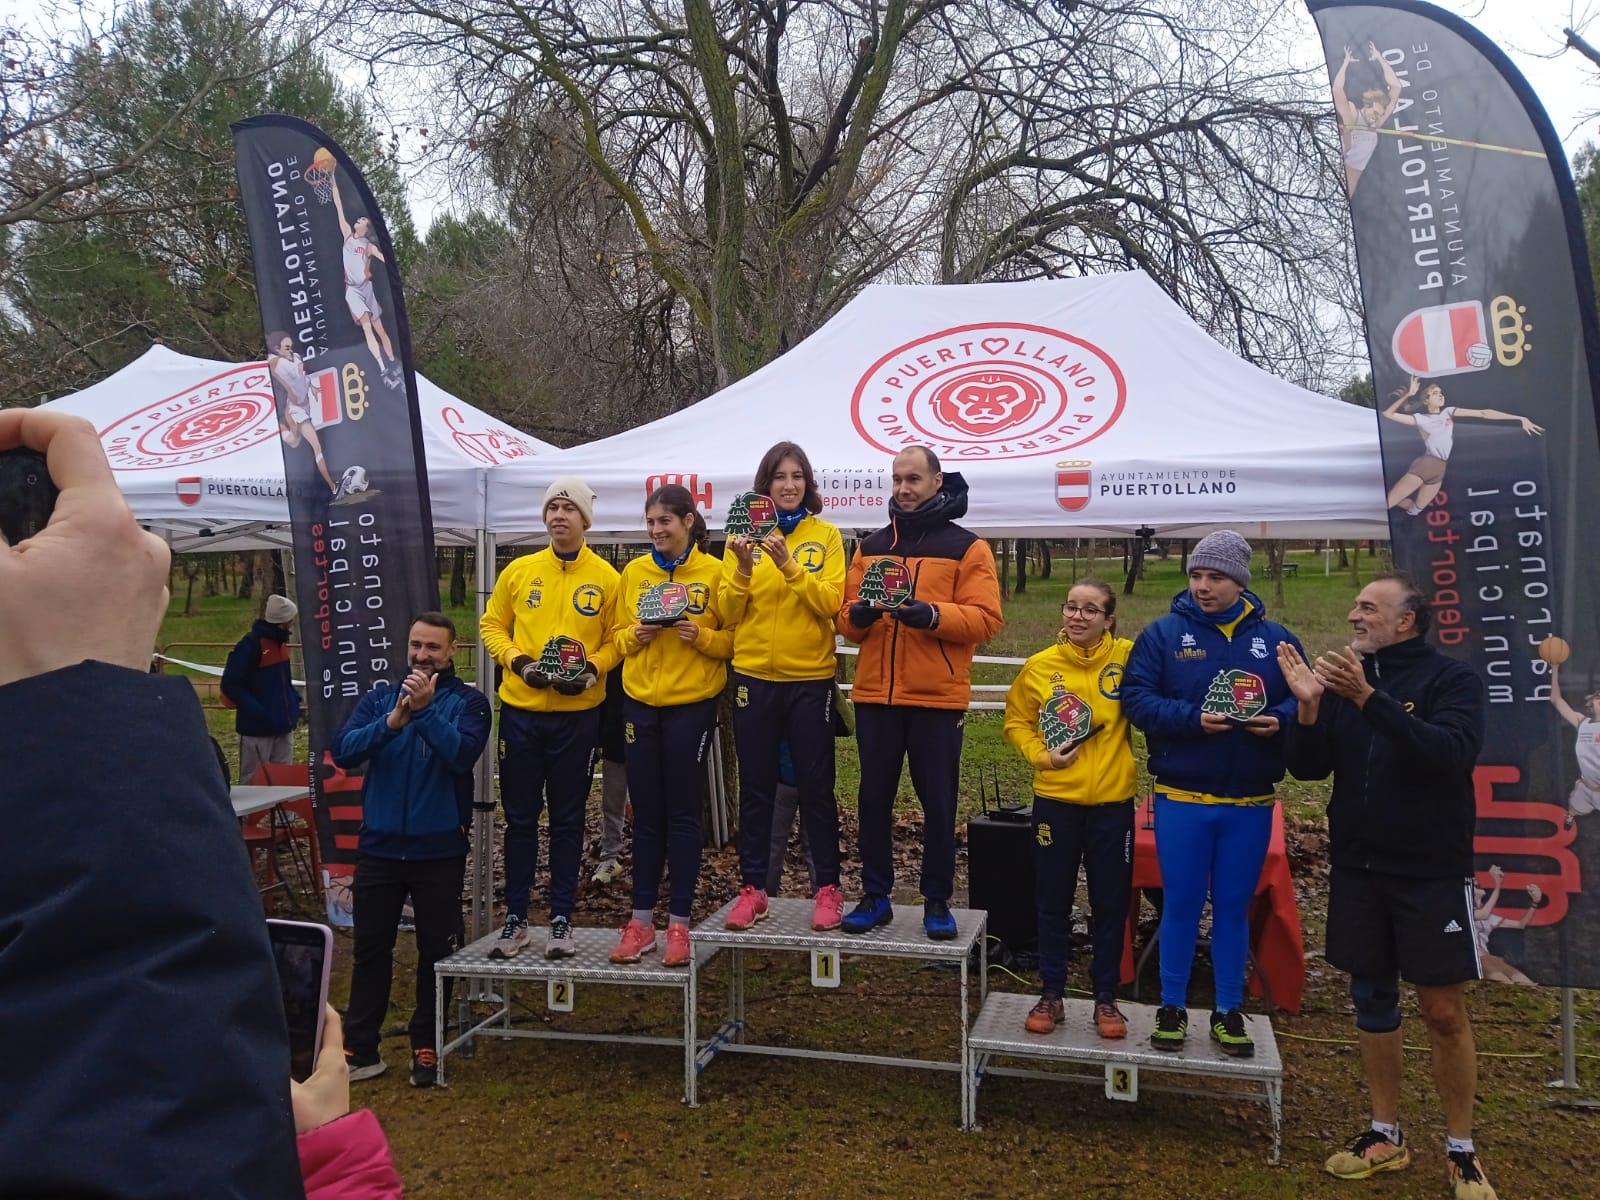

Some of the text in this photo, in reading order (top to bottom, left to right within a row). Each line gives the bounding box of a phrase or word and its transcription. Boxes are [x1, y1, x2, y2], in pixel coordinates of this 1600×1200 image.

[1100, 469, 1237, 482] AYUNTAMIENTO DE
[823, 476, 883, 492] icipal
[1100, 481, 1237, 497] PUERTOLLANO
[823, 494, 883, 509] eportes
[821, 956, 830, 976] 1
[555, 982, 565, 1002] 2
[1116, 1070, 1128, 1091] 3
